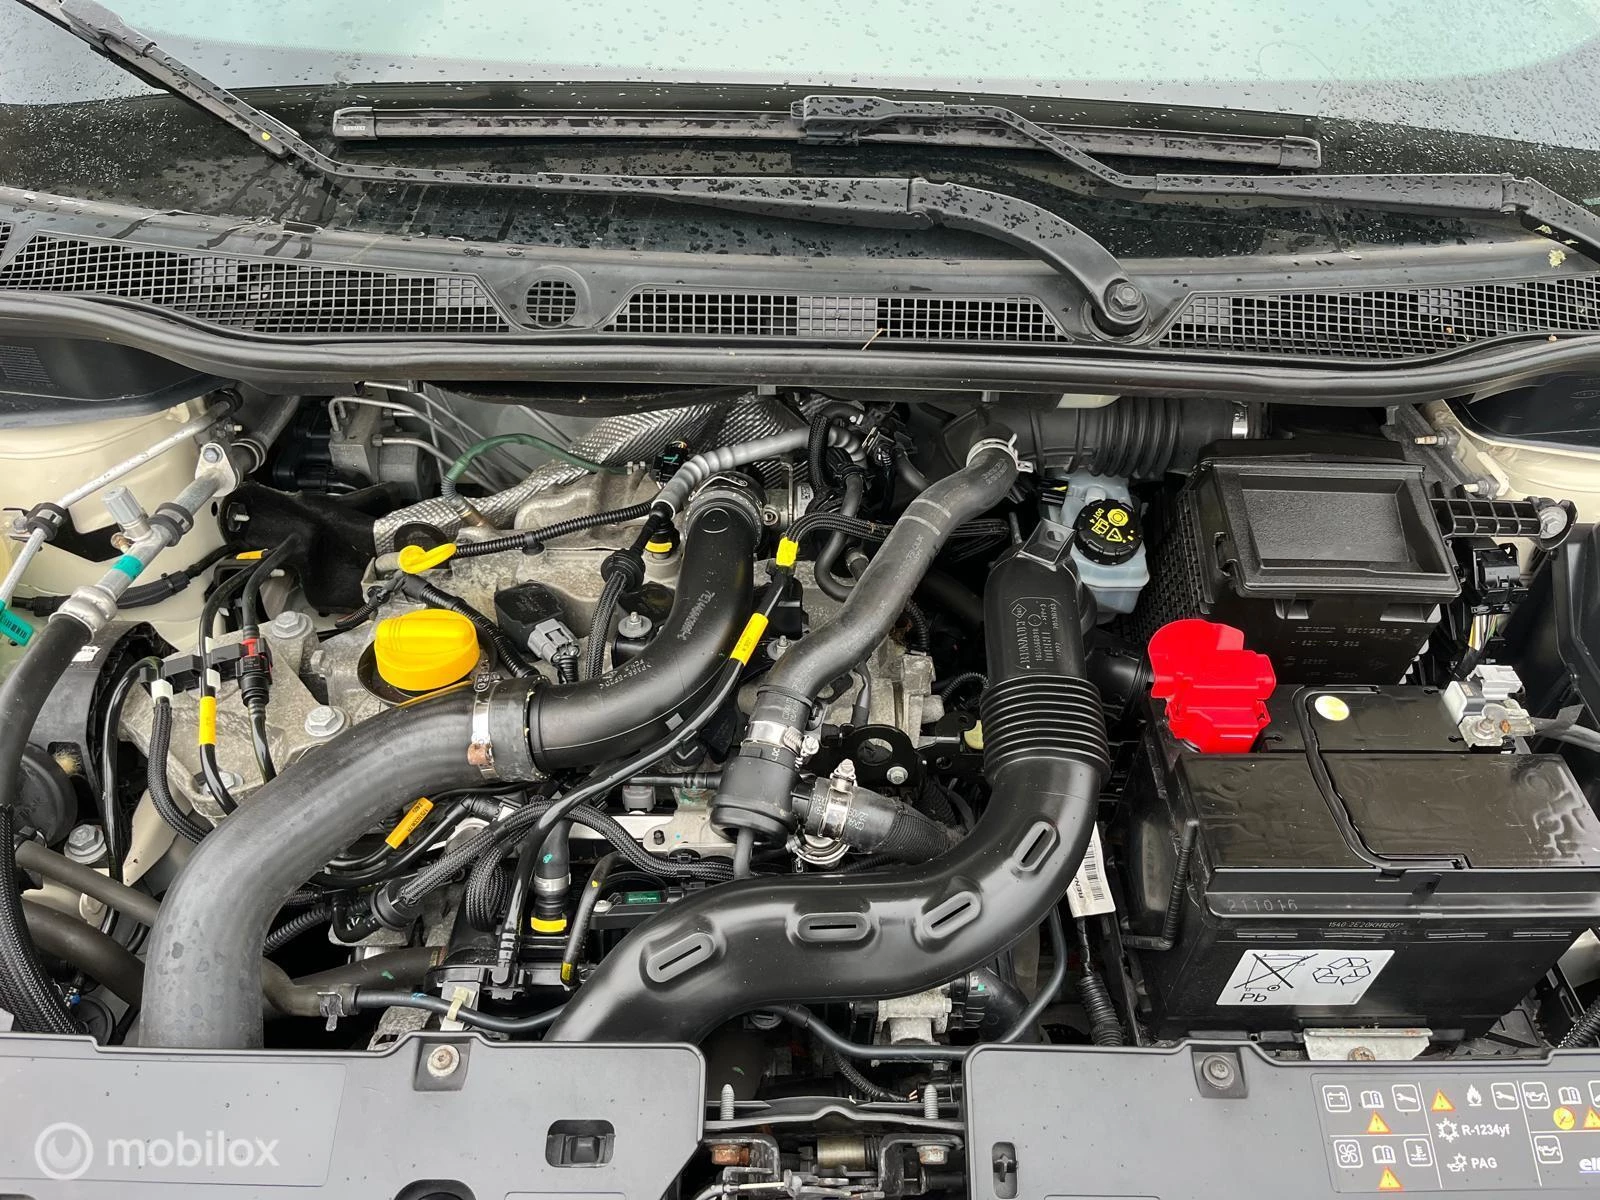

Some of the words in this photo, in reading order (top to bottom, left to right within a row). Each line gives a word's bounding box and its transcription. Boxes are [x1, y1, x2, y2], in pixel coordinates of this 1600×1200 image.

[1093, 508, 1105, 519] DOT
[1240, 993, 1267, 1002] Pb
[1461, 1125, 1511, 1136] R-1234yf
[1471, 1157, 1498, 1169] PAG
